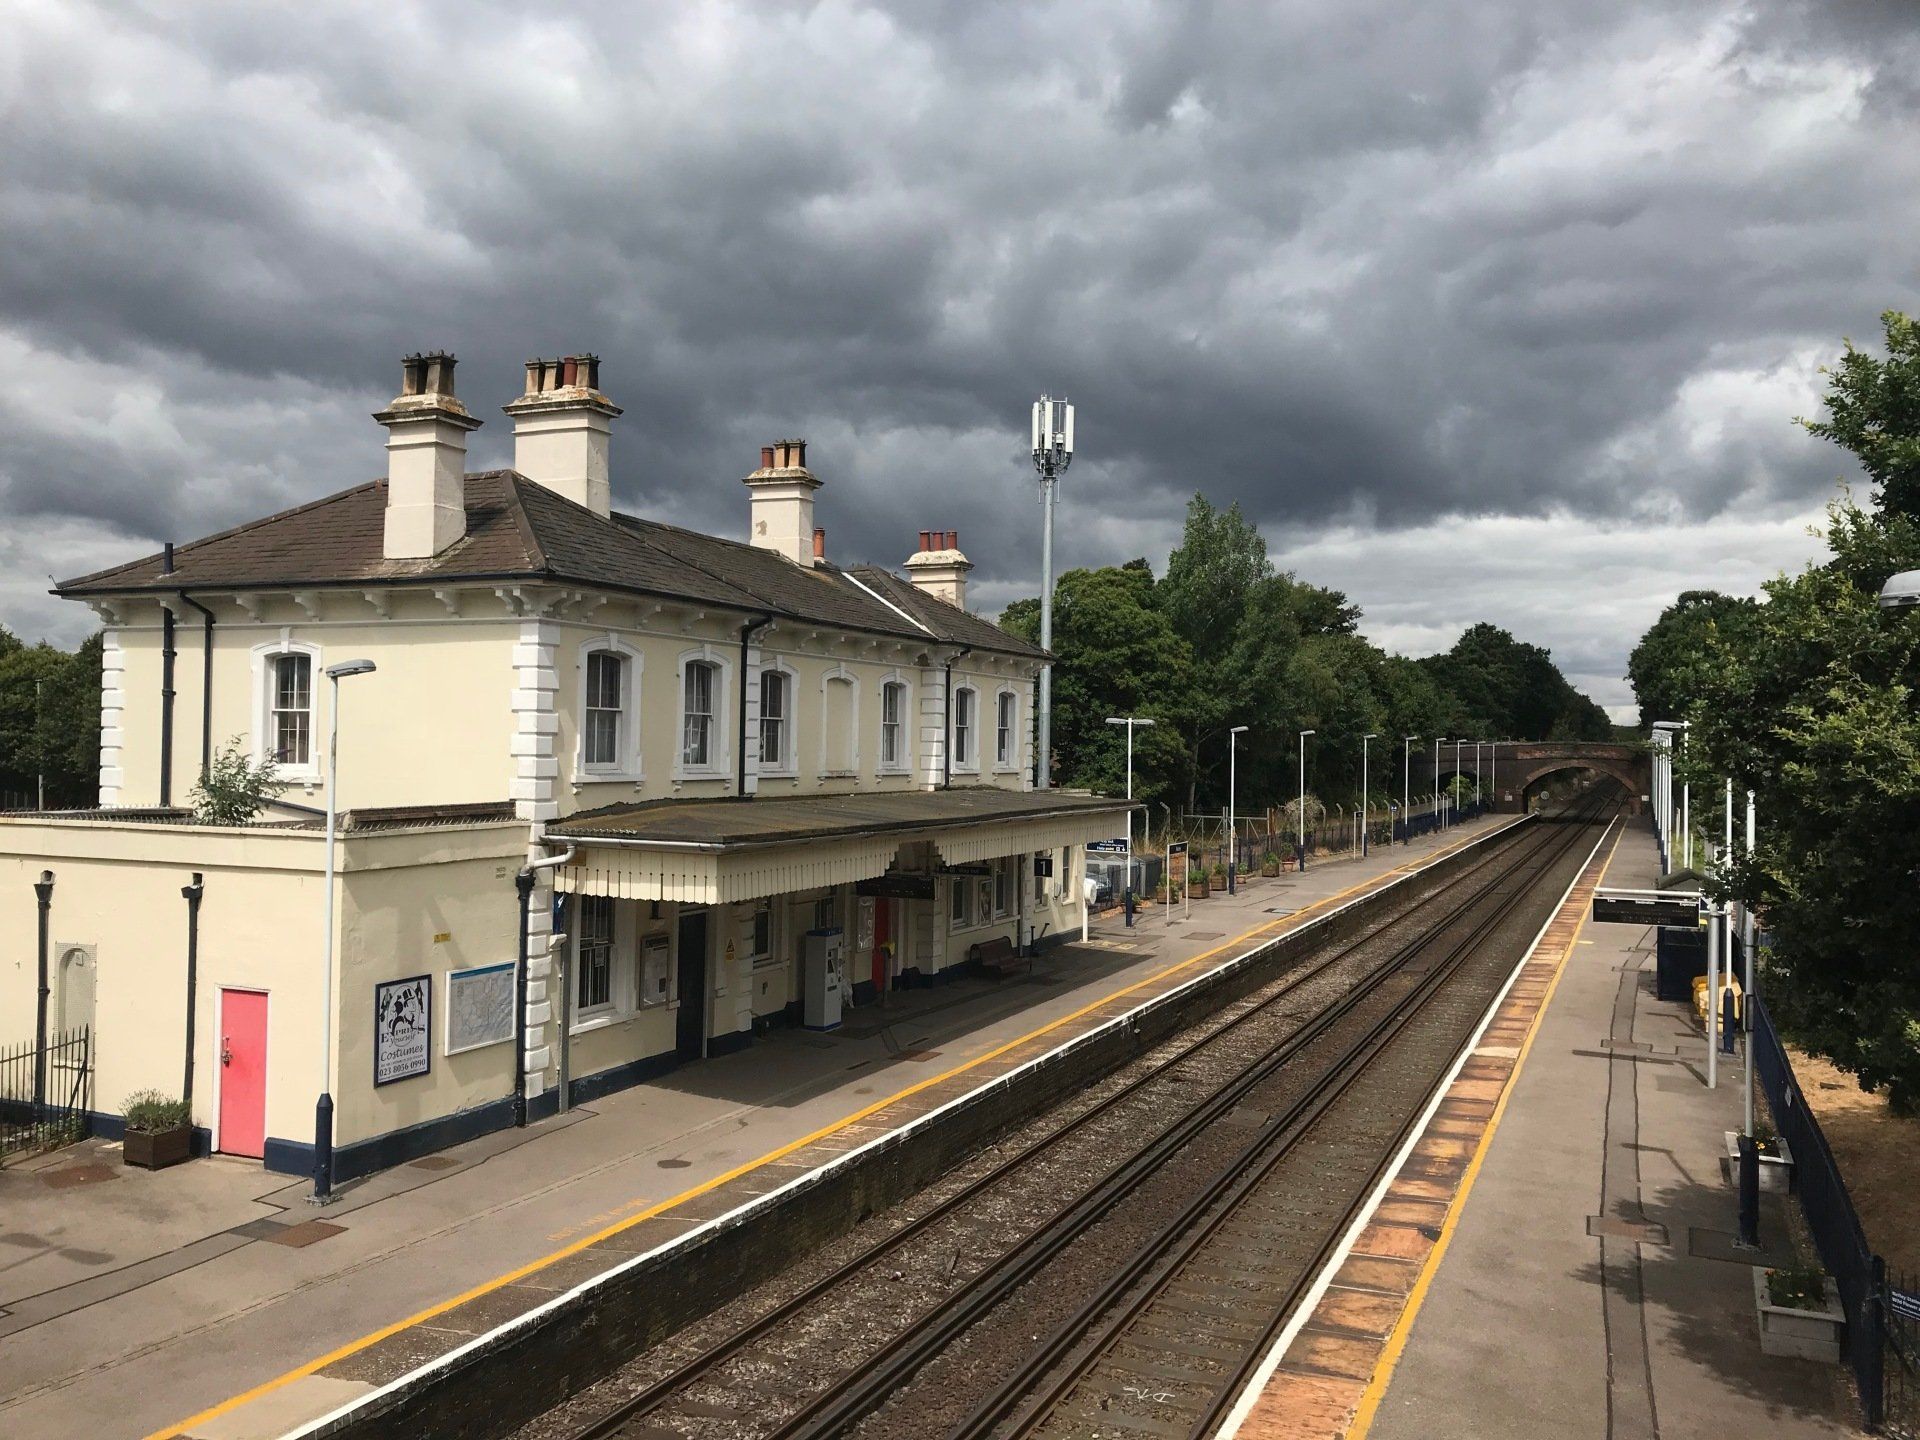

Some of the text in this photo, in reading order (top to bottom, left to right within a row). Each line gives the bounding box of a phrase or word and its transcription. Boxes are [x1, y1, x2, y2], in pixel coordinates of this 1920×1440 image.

[1040, 861, 1046, 876] 1
[380, 1044, 424, 1061] Costumes
[379, 1067, 391, 1077] 023
